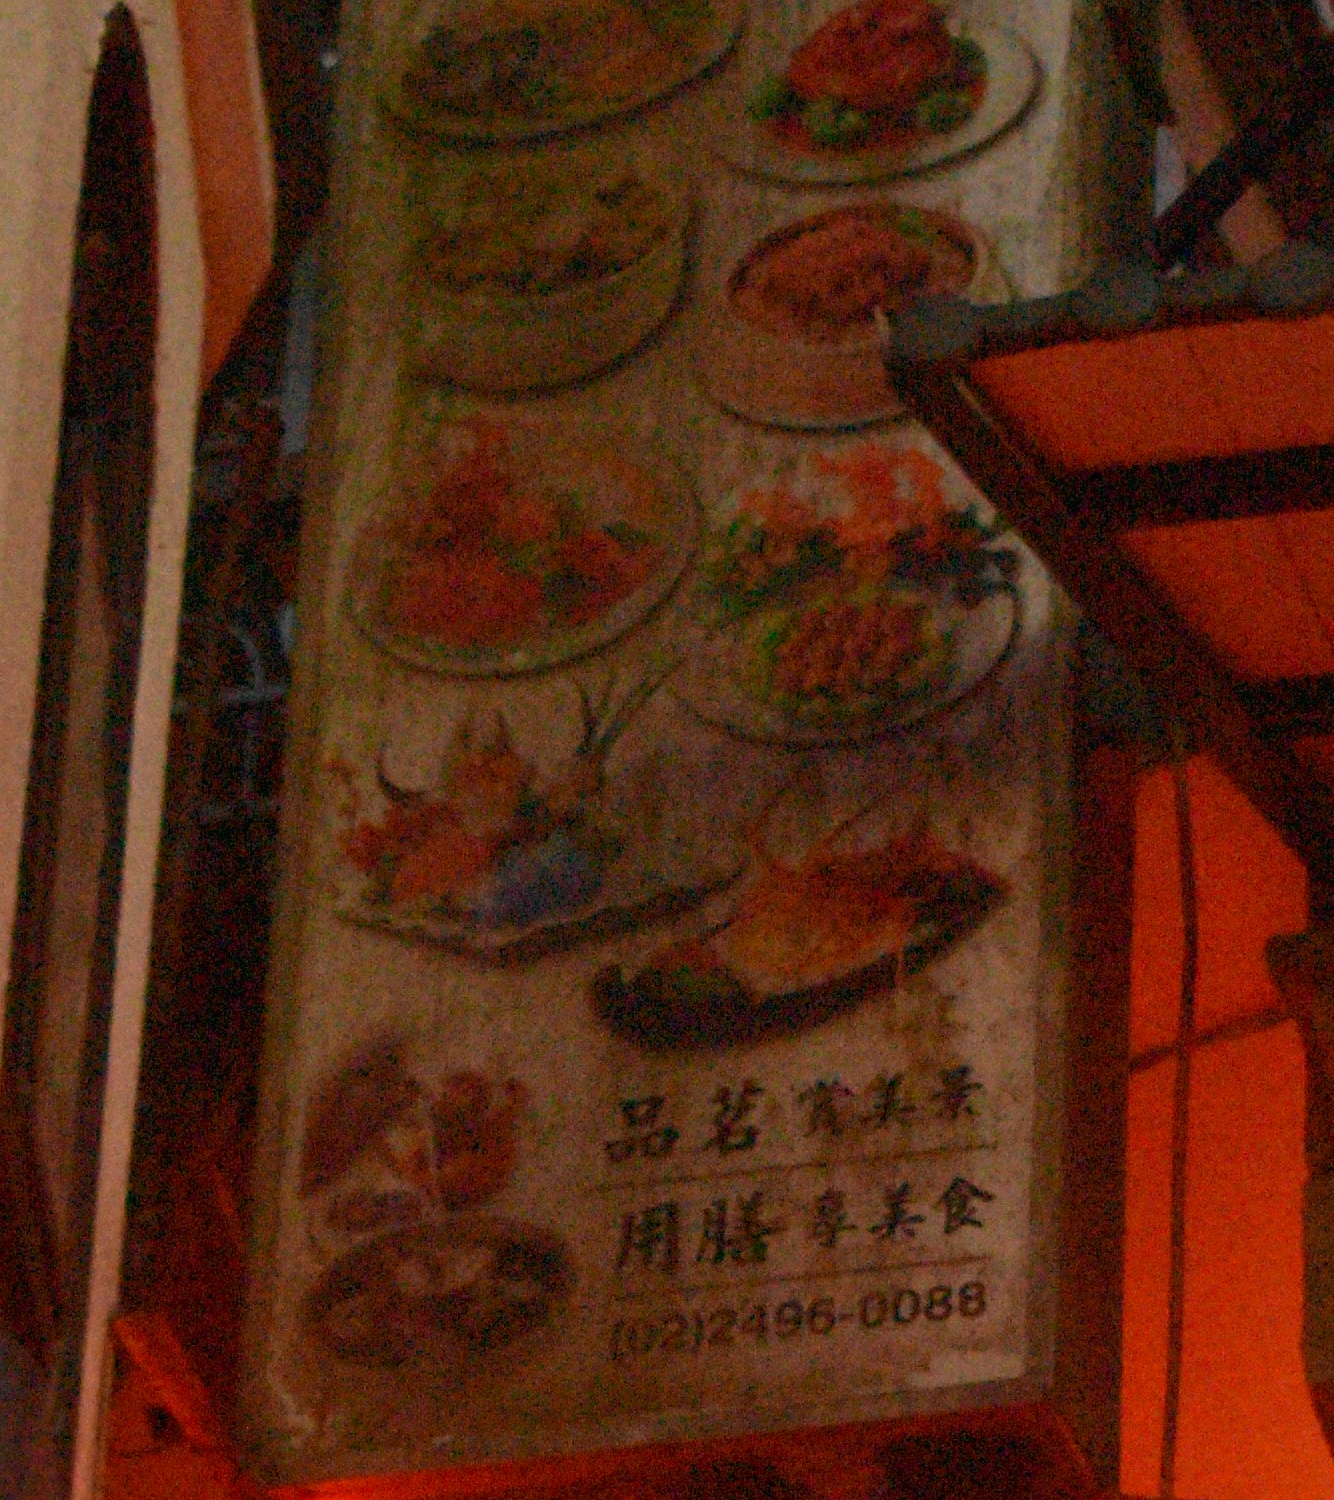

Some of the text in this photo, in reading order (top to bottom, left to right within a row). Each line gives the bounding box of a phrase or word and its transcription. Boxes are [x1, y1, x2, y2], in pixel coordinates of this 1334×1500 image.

[616, 1177, 996, 1275] 用膳享美食
[608, 1280, 988, 1363] (02)2496-0088
